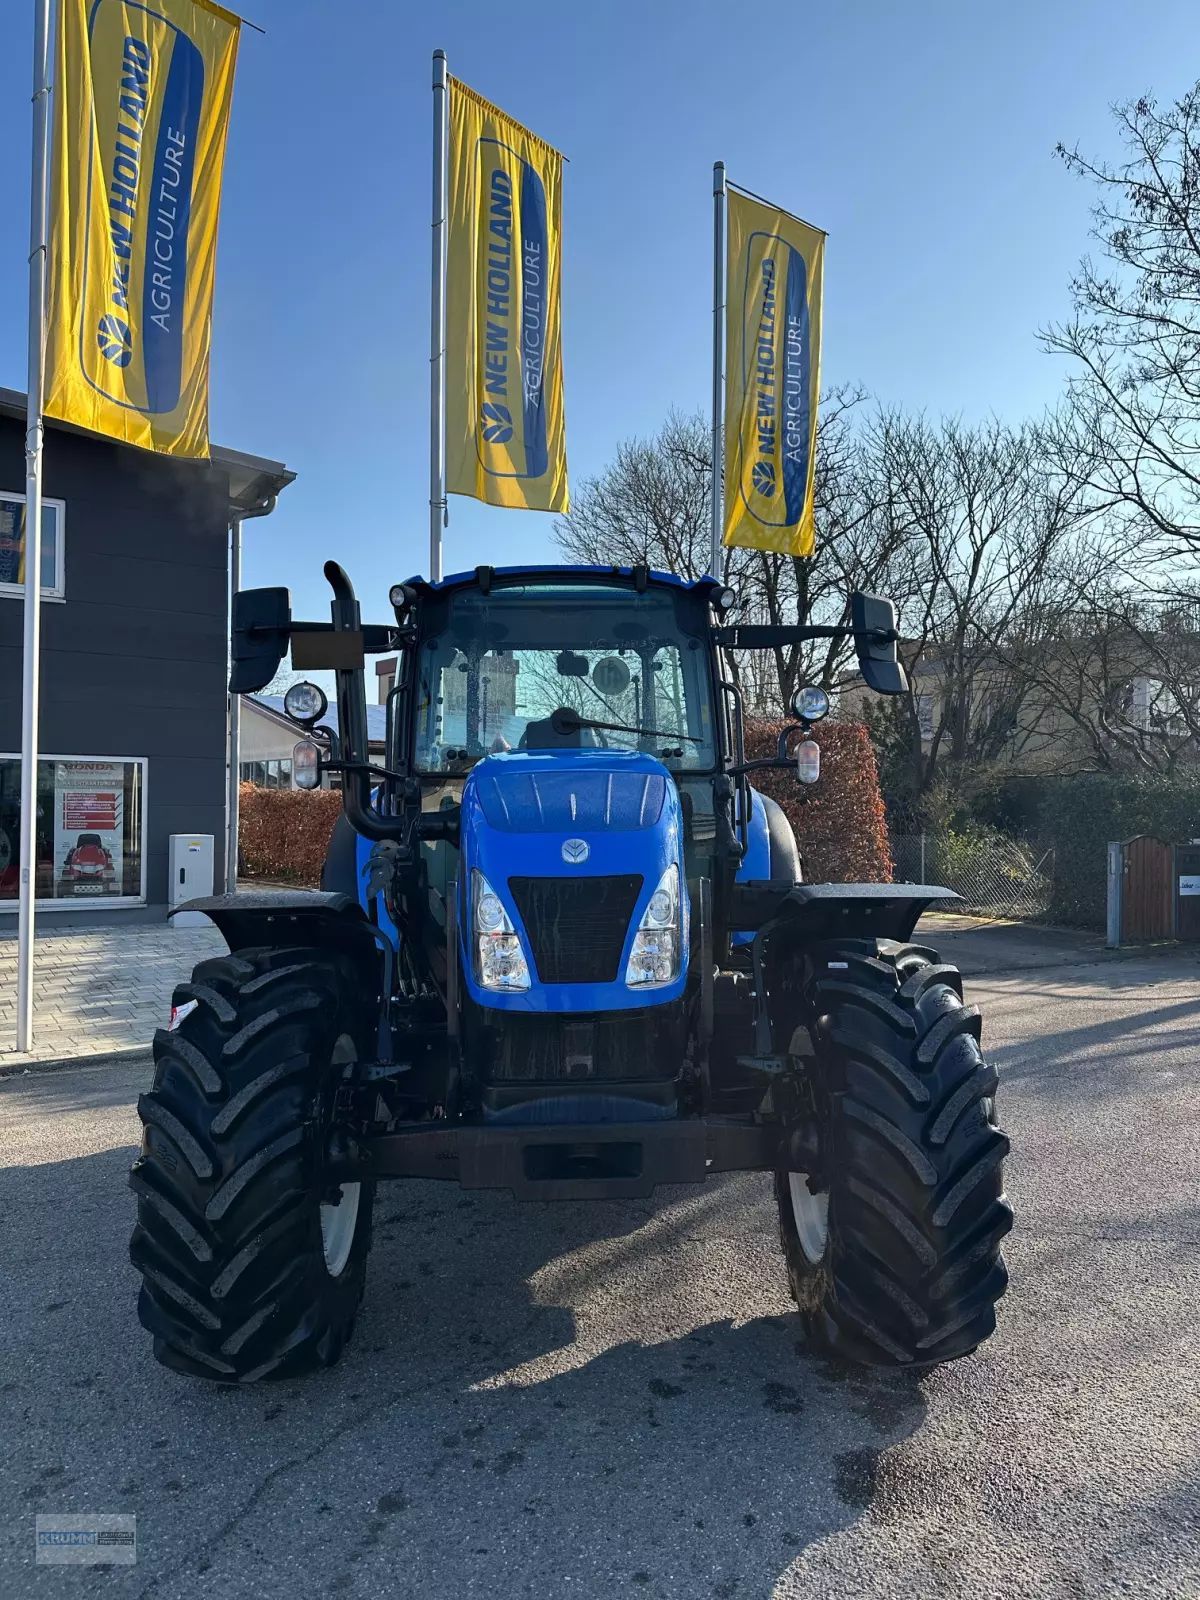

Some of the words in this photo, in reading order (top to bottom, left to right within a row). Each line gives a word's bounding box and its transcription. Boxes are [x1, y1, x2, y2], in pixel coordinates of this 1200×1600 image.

[110, 36, 150, 219] HOLLAND
[110, 219, 133, 309] NEW
[150, 126, 186, 333] AGRICULTURE
[487, 170, 512, 317] HOLLAND
[485, 320, 509, 396] NEW
[525, 240, 541, 409] AGRICULTURE
[757, 258, 775, 386] HOLLAND
[787, 315, 802, 463] AGRICULTURE
[757, 391, 775, 455] NEW
